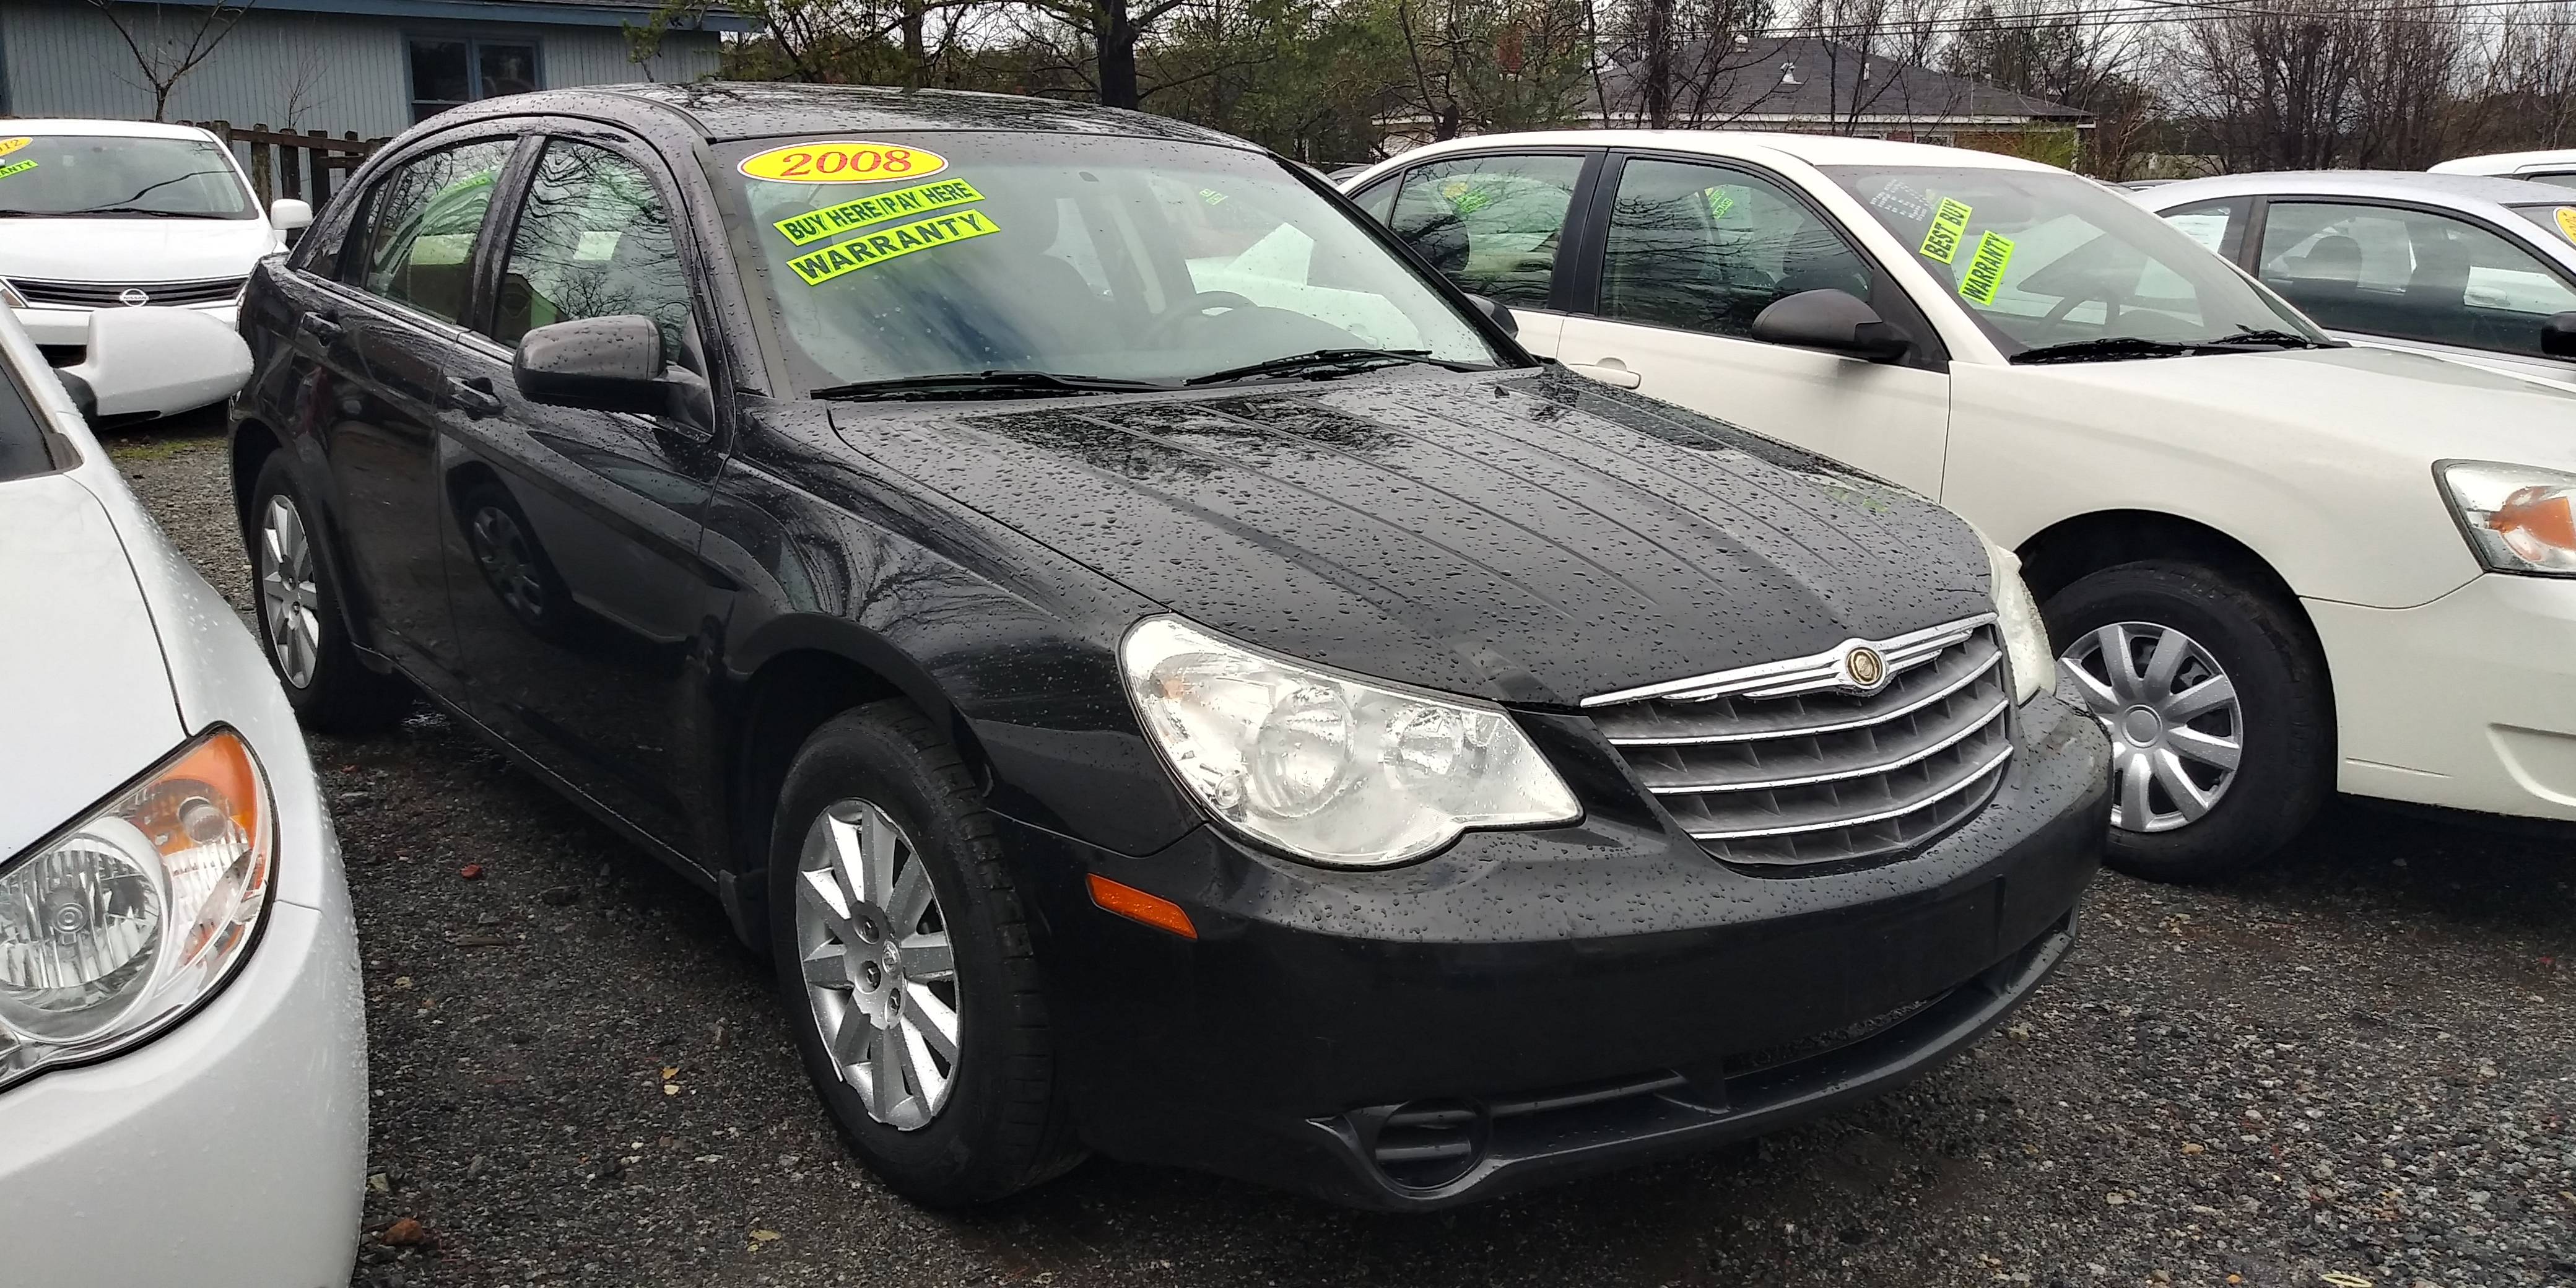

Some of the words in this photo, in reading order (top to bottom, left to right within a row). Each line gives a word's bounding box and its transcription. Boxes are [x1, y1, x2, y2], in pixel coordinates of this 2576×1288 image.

[780, 149, 911, 176] 2008
[783, 214, 829, 240] BUY
[825, 191, 921, 227] HERE/PAY
[919, 182, 974, 204] HERE
[1939, 199, 1968, 227] BUY
[794, 214, 982, 279] WARRANTY
[1924, 222, 1958, 259] BEST
[1962, 233, 2010, 302] WARRANTY
